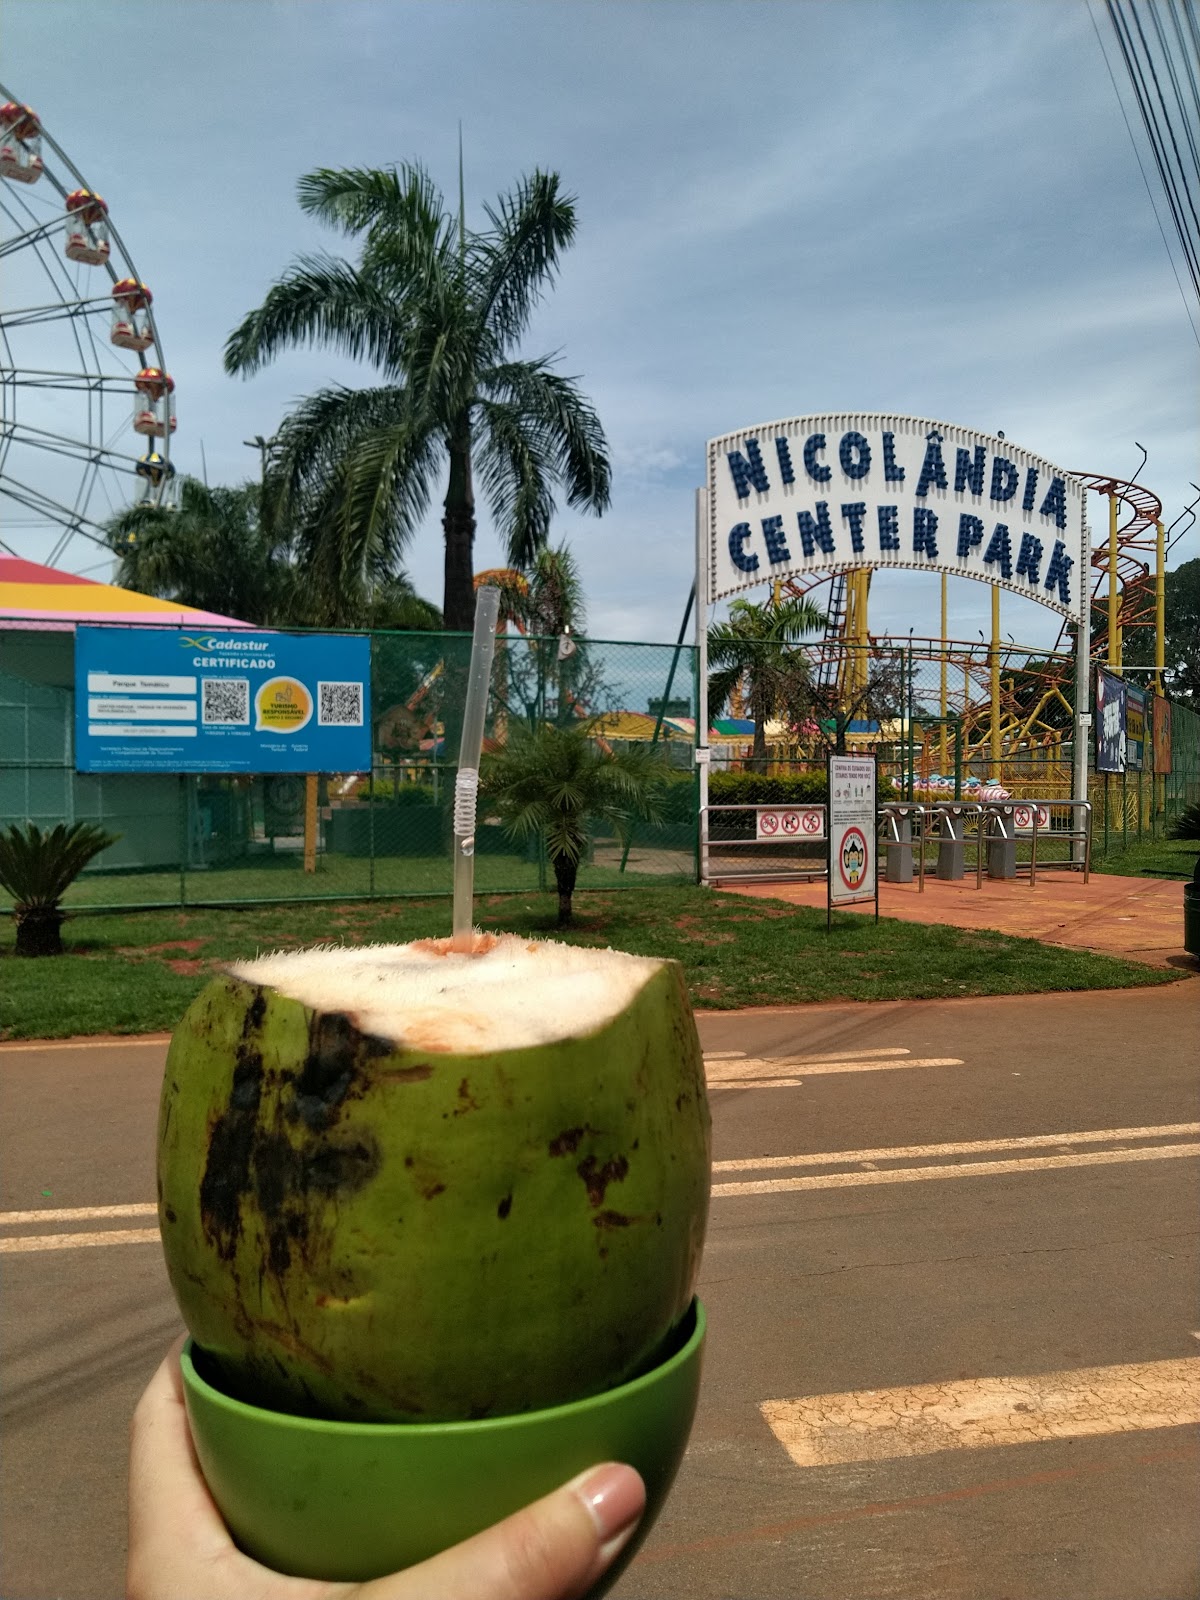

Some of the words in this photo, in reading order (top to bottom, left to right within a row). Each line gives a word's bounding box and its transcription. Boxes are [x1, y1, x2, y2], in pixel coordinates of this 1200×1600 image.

[727, 430, 1067, 530] NICOLÂNDIA
[728, 501, 939, 573] CENTER
[956, 512, 1074, 605] PARK
[193, 657, 276, 669] CERTIFICADO
[207, 638, 269, 651] Cadastur
